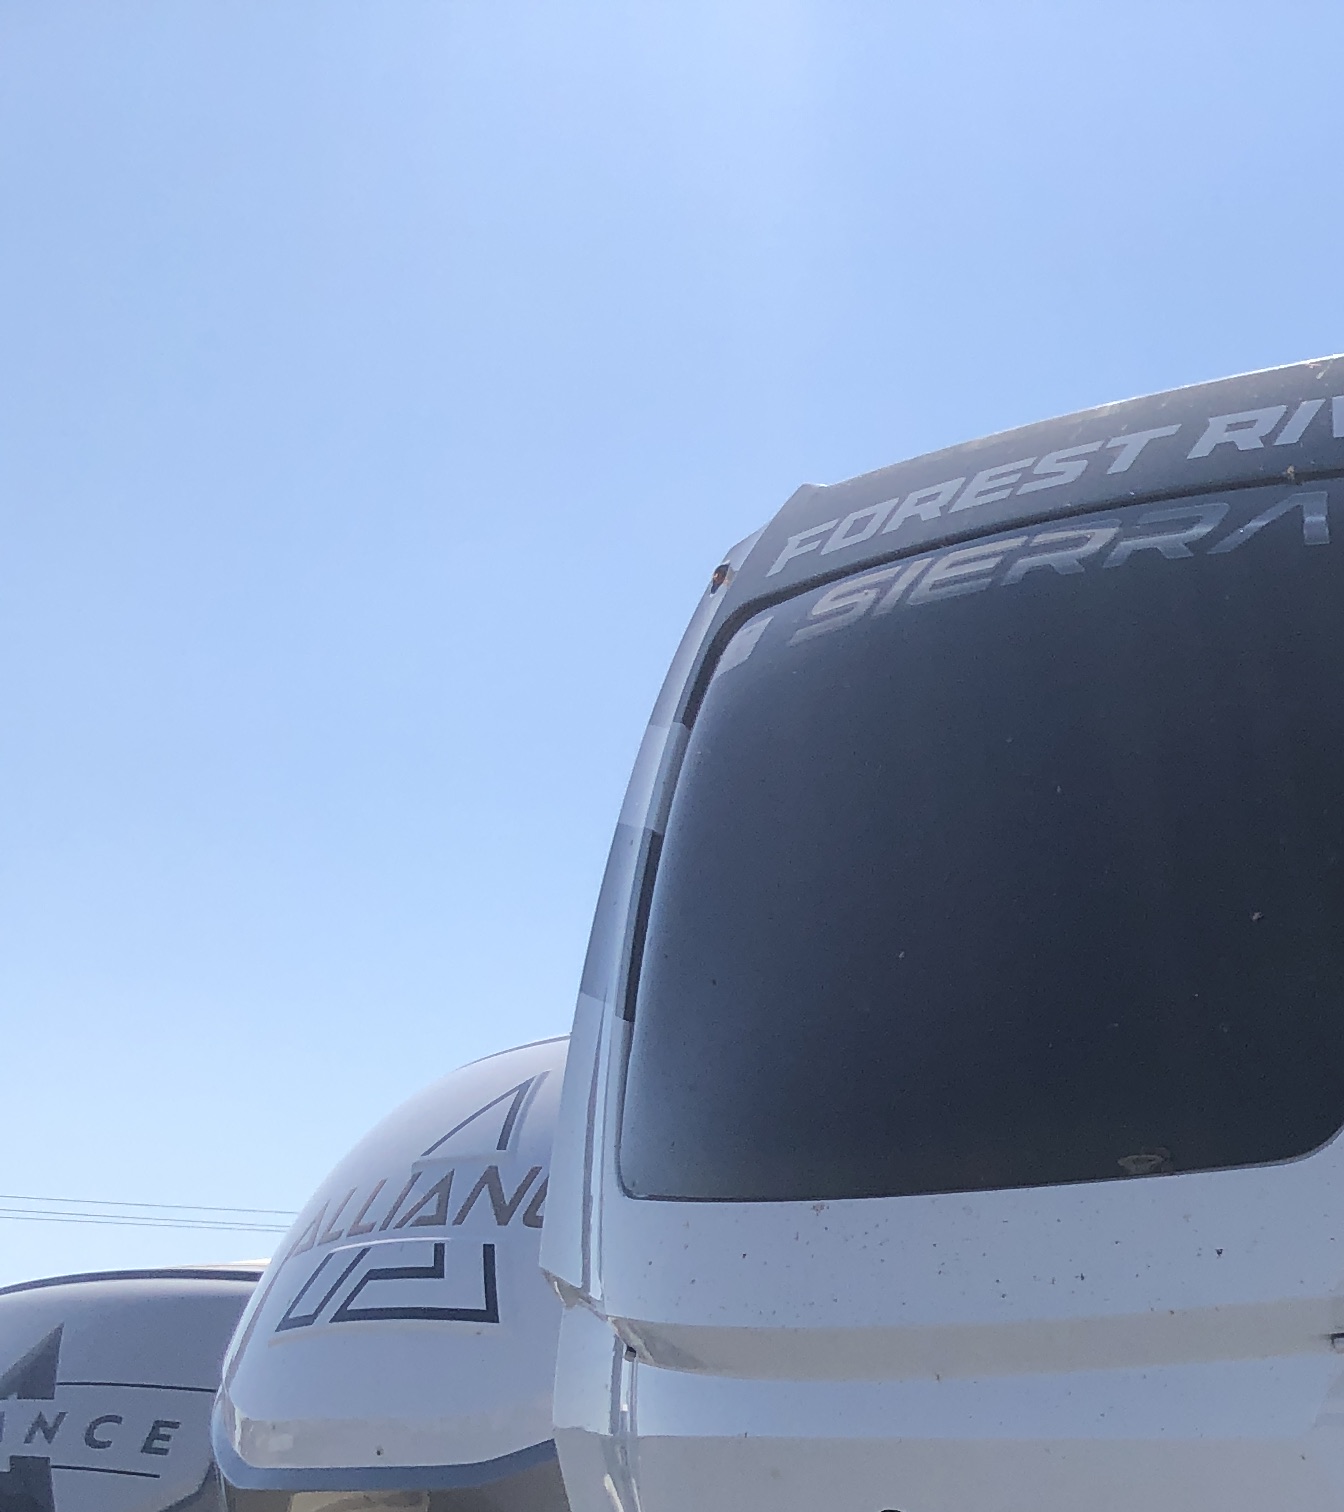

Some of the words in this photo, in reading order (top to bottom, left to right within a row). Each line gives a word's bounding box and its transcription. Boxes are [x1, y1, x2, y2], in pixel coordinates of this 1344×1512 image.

[766, 424, 1182, 577] FOREST
[791, 491, 1331, 648] SIERRA
[0, 1410, 182, 1456] NCE
